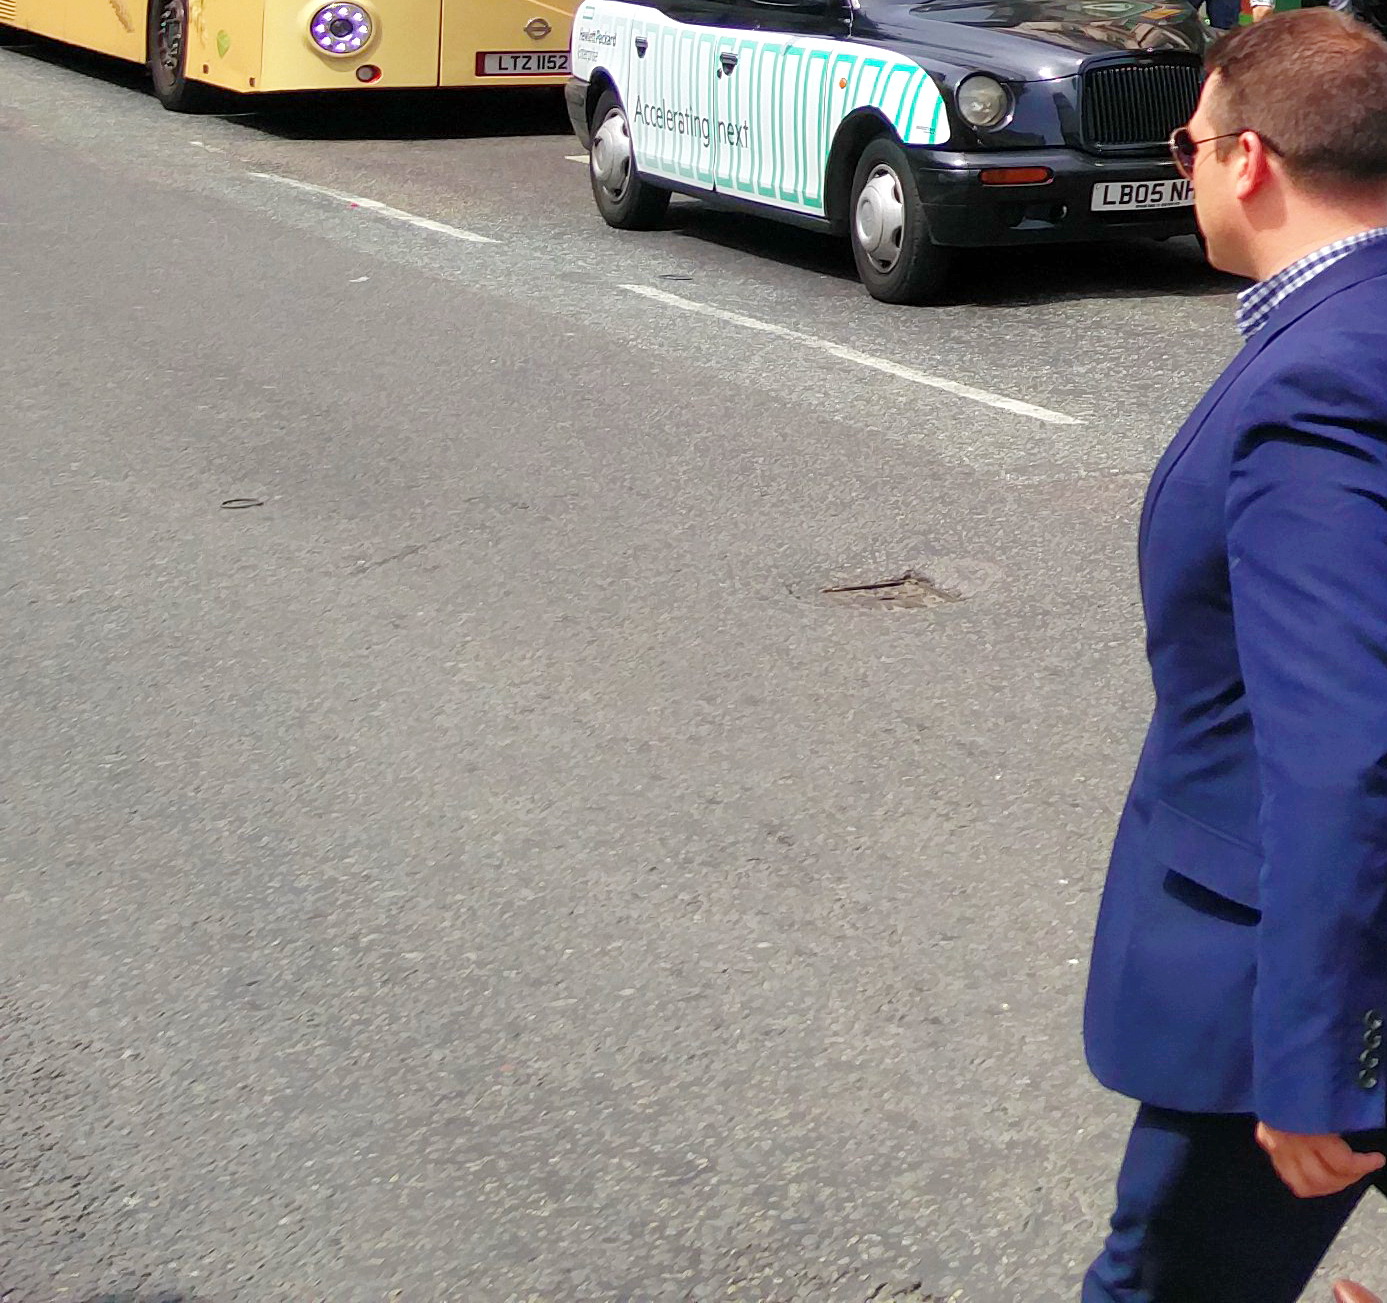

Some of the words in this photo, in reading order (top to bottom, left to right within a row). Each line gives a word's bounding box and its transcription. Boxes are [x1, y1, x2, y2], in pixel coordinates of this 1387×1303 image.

[498, 55, 532, 70] LTZ
[537, 55, 569, 70] 1152
[634, 94, 711, 148] Accelerating
[718, 119, 749, 148] next
[1103, 182, 1165, 205] LB05
